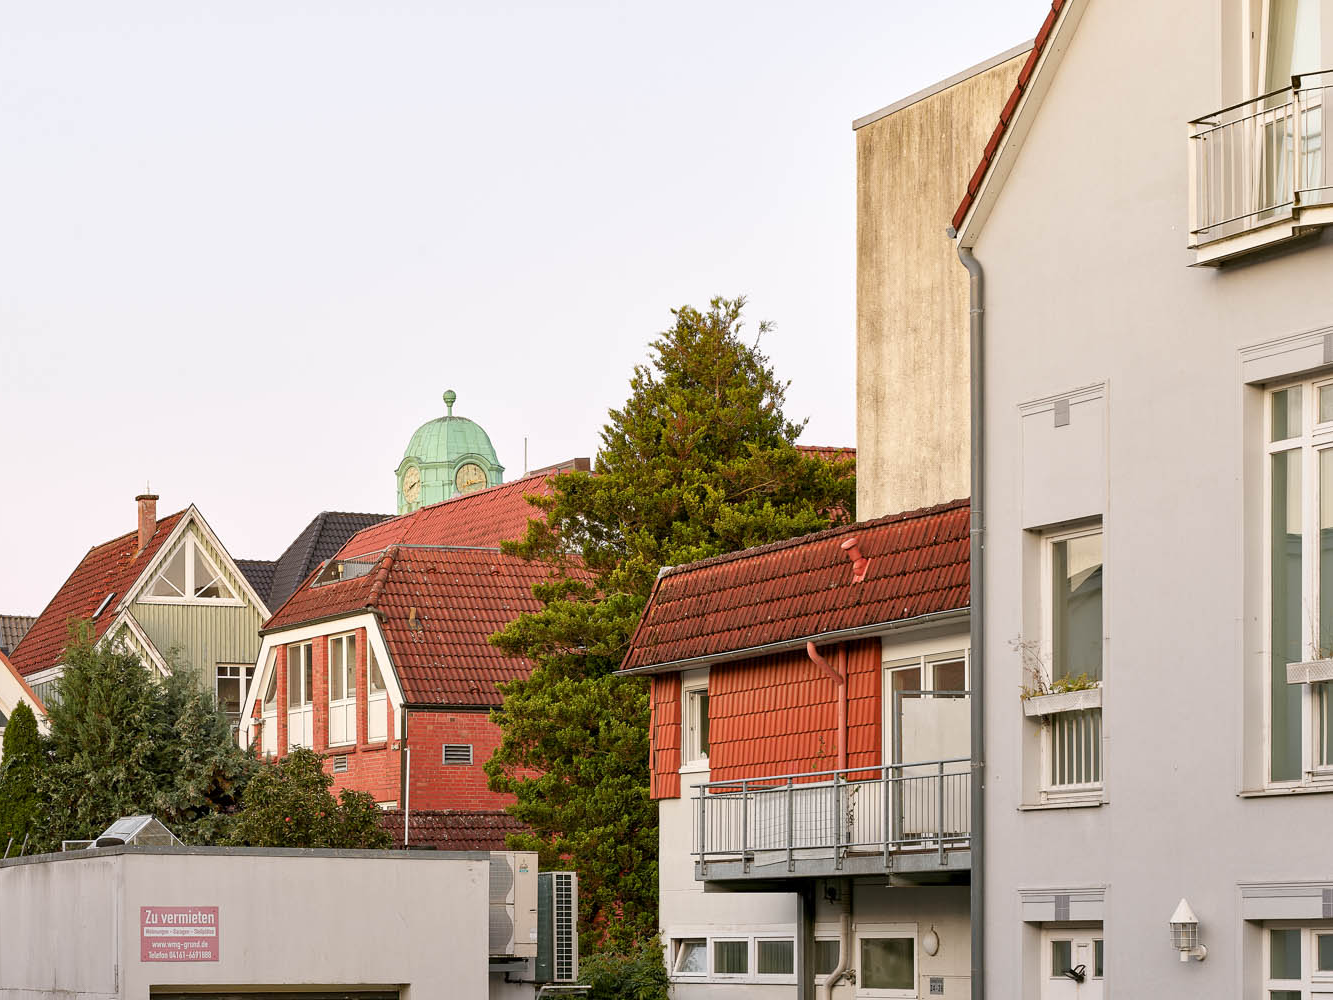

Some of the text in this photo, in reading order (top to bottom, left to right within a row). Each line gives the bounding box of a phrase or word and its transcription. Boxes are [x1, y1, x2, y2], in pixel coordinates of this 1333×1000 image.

[146, 910, 214, 924] Zu vermieten
[152, 941, 208, 950] www.wmg-grund.de
[148, 951, 168, 959] Telefon
